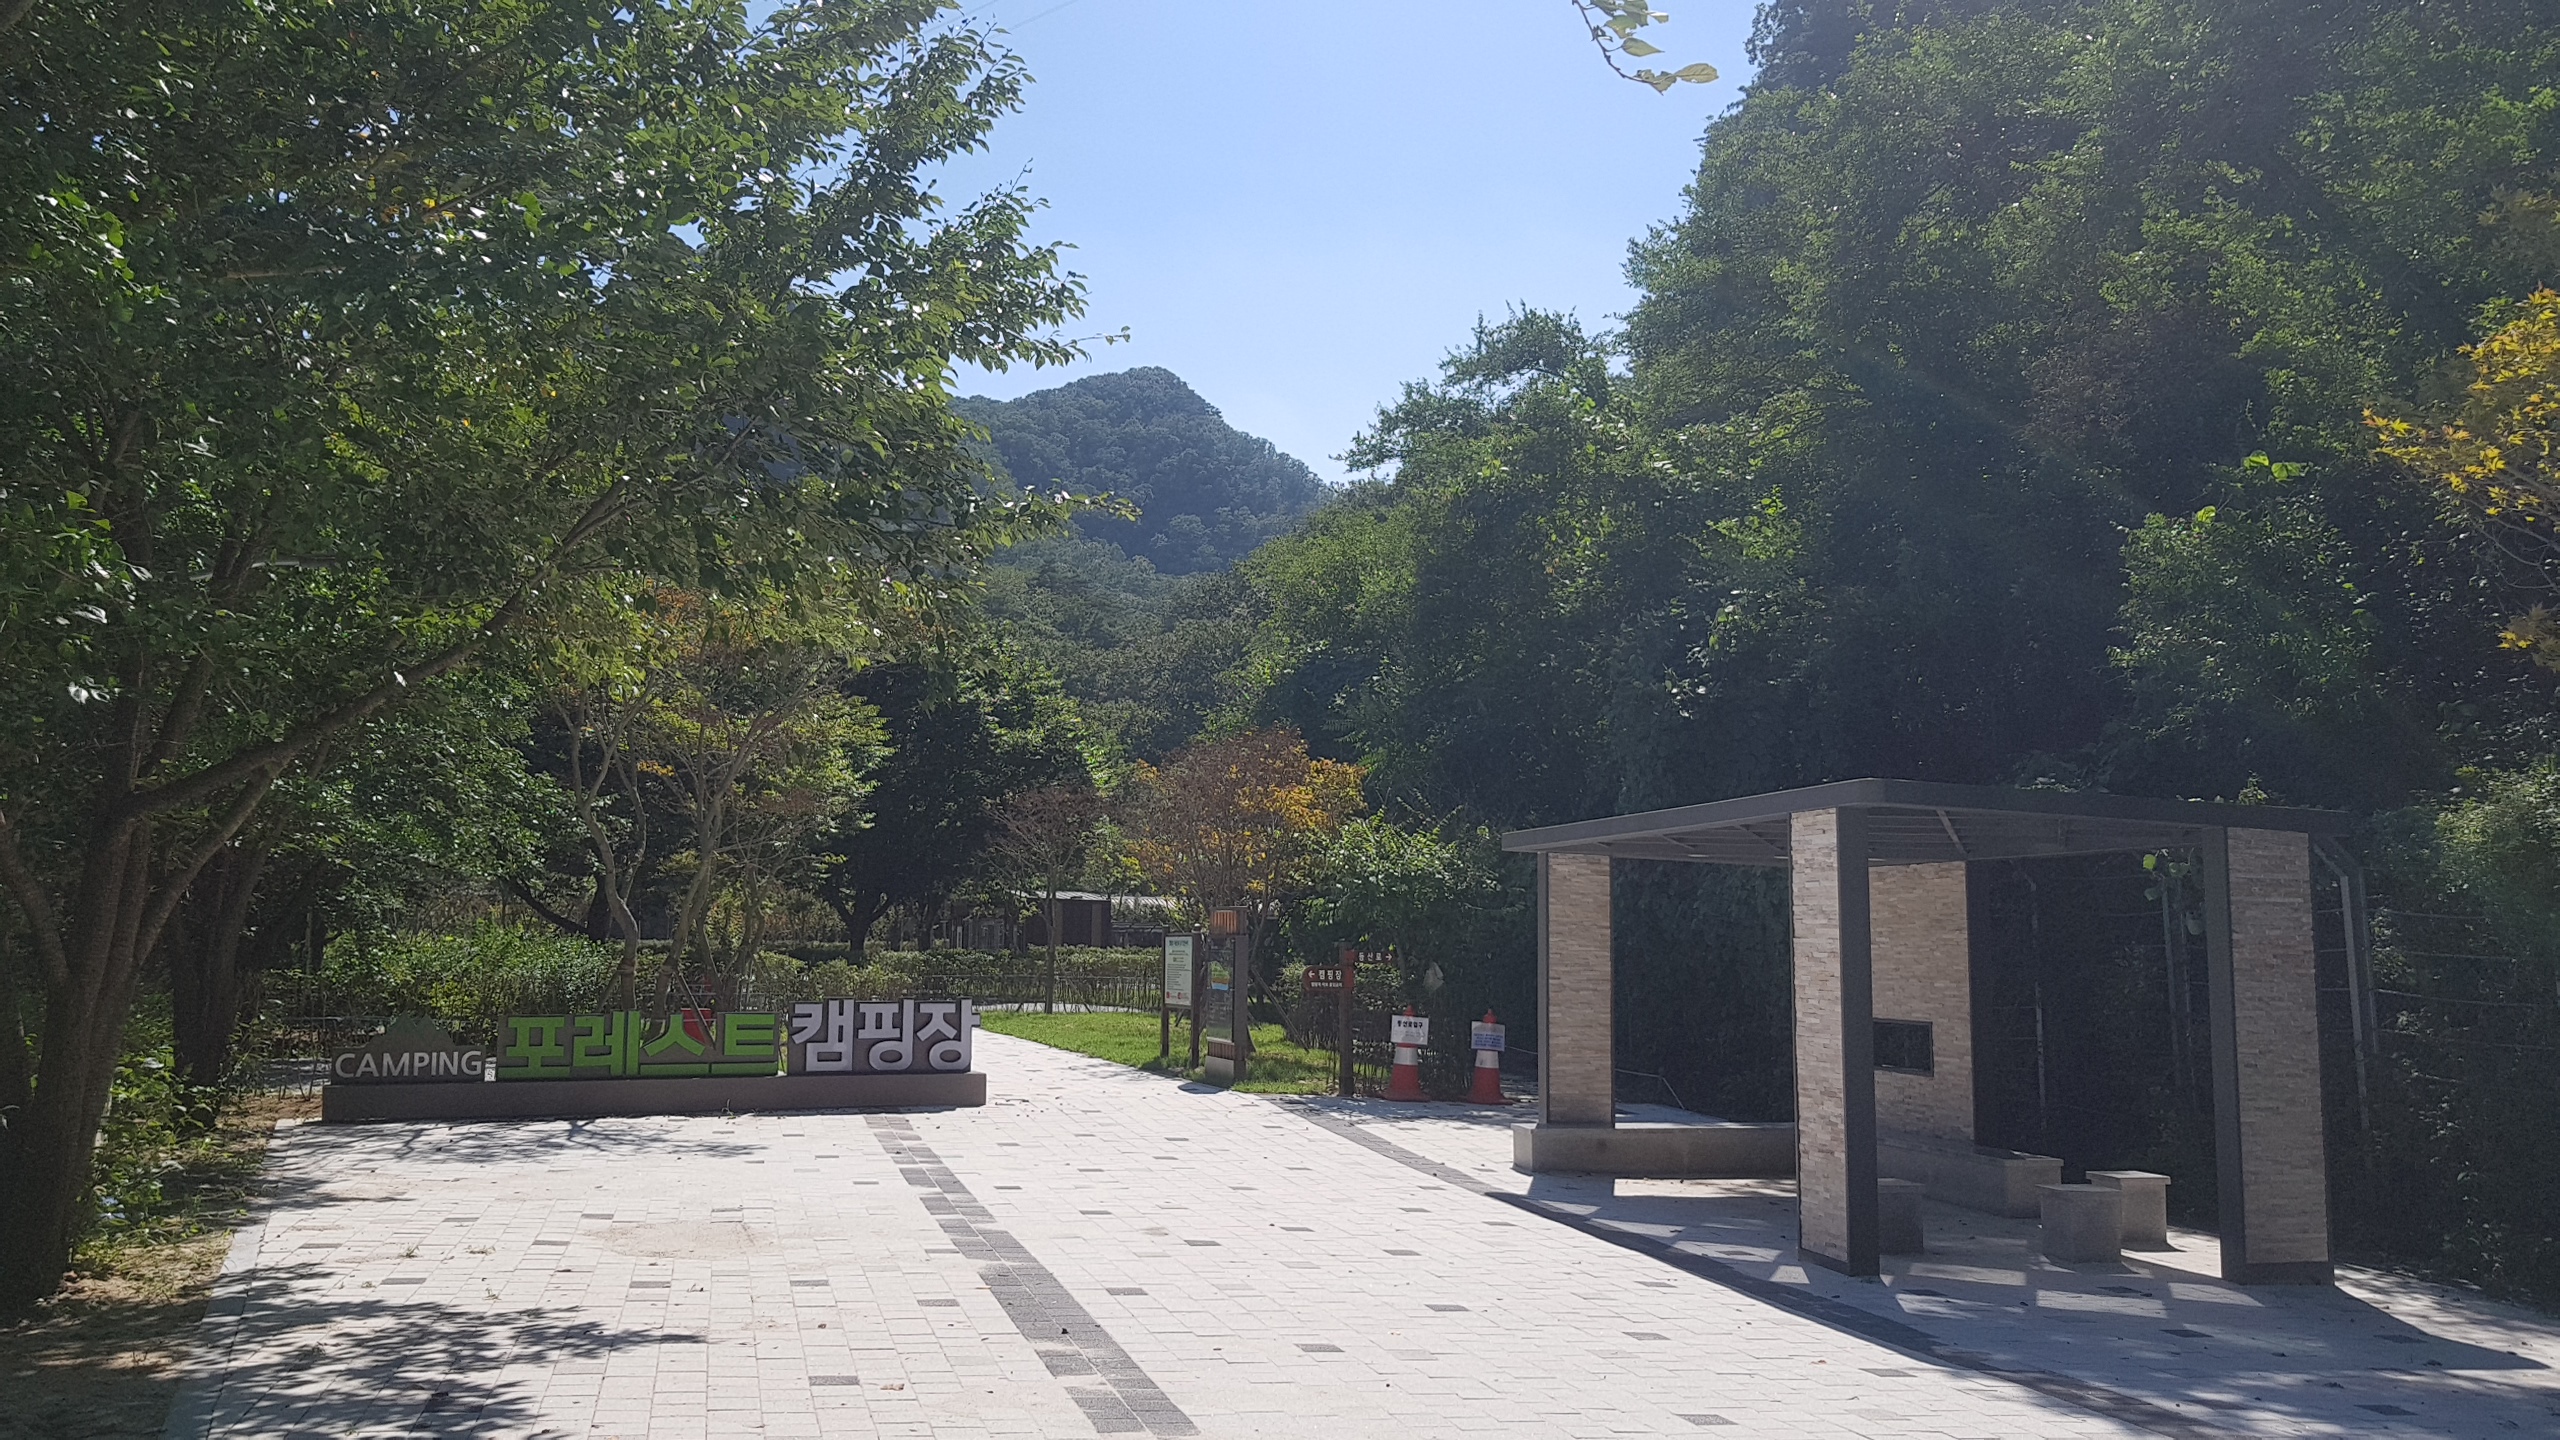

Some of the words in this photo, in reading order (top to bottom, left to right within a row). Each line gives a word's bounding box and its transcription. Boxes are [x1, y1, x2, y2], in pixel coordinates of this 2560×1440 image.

[1358, 951, 1382, 962] 등산로
[1318, 969, 1342, 980] 캠핑장
[499, 1010, 777, 1077] 포레스트
[792, 1000, 981, 1072] 캠핑장
[335, 1050, 482, 1078] CAMPING
